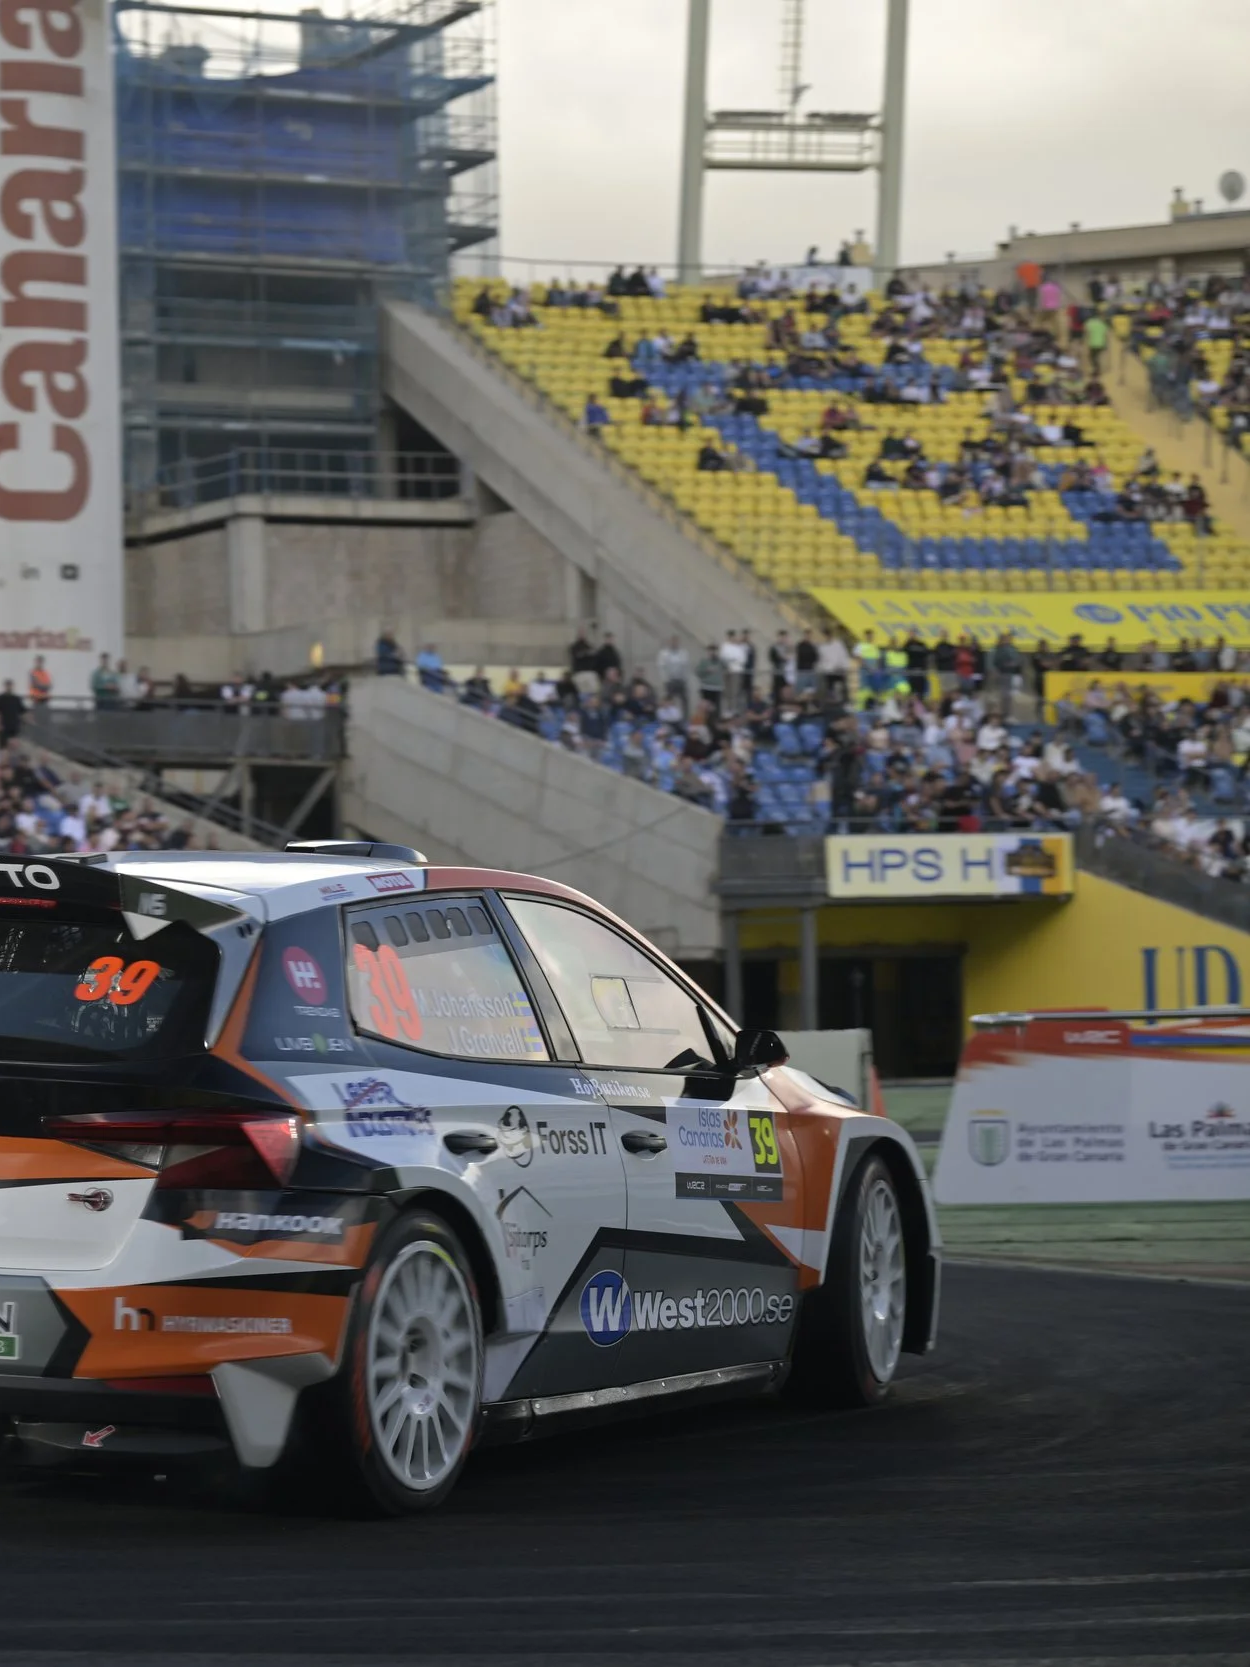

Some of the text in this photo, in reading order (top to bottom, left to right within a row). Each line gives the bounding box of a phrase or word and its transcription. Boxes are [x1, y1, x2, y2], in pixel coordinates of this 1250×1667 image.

[841, 846, 944, 883] HPS
[74, 956, 161, 1005] 39
[353, 943, 423, 1041] 39
[678, 1125, 725, 1148] Canarias
[698, 1107, 721, 1129] Islas
[1149, 1121, 1185, 1138] Las
[536, 1121, 607, 1155] Forss IT
[749, 1117, 779, 1165] 39
[634, 1287, 794, 1330] West2000.se
